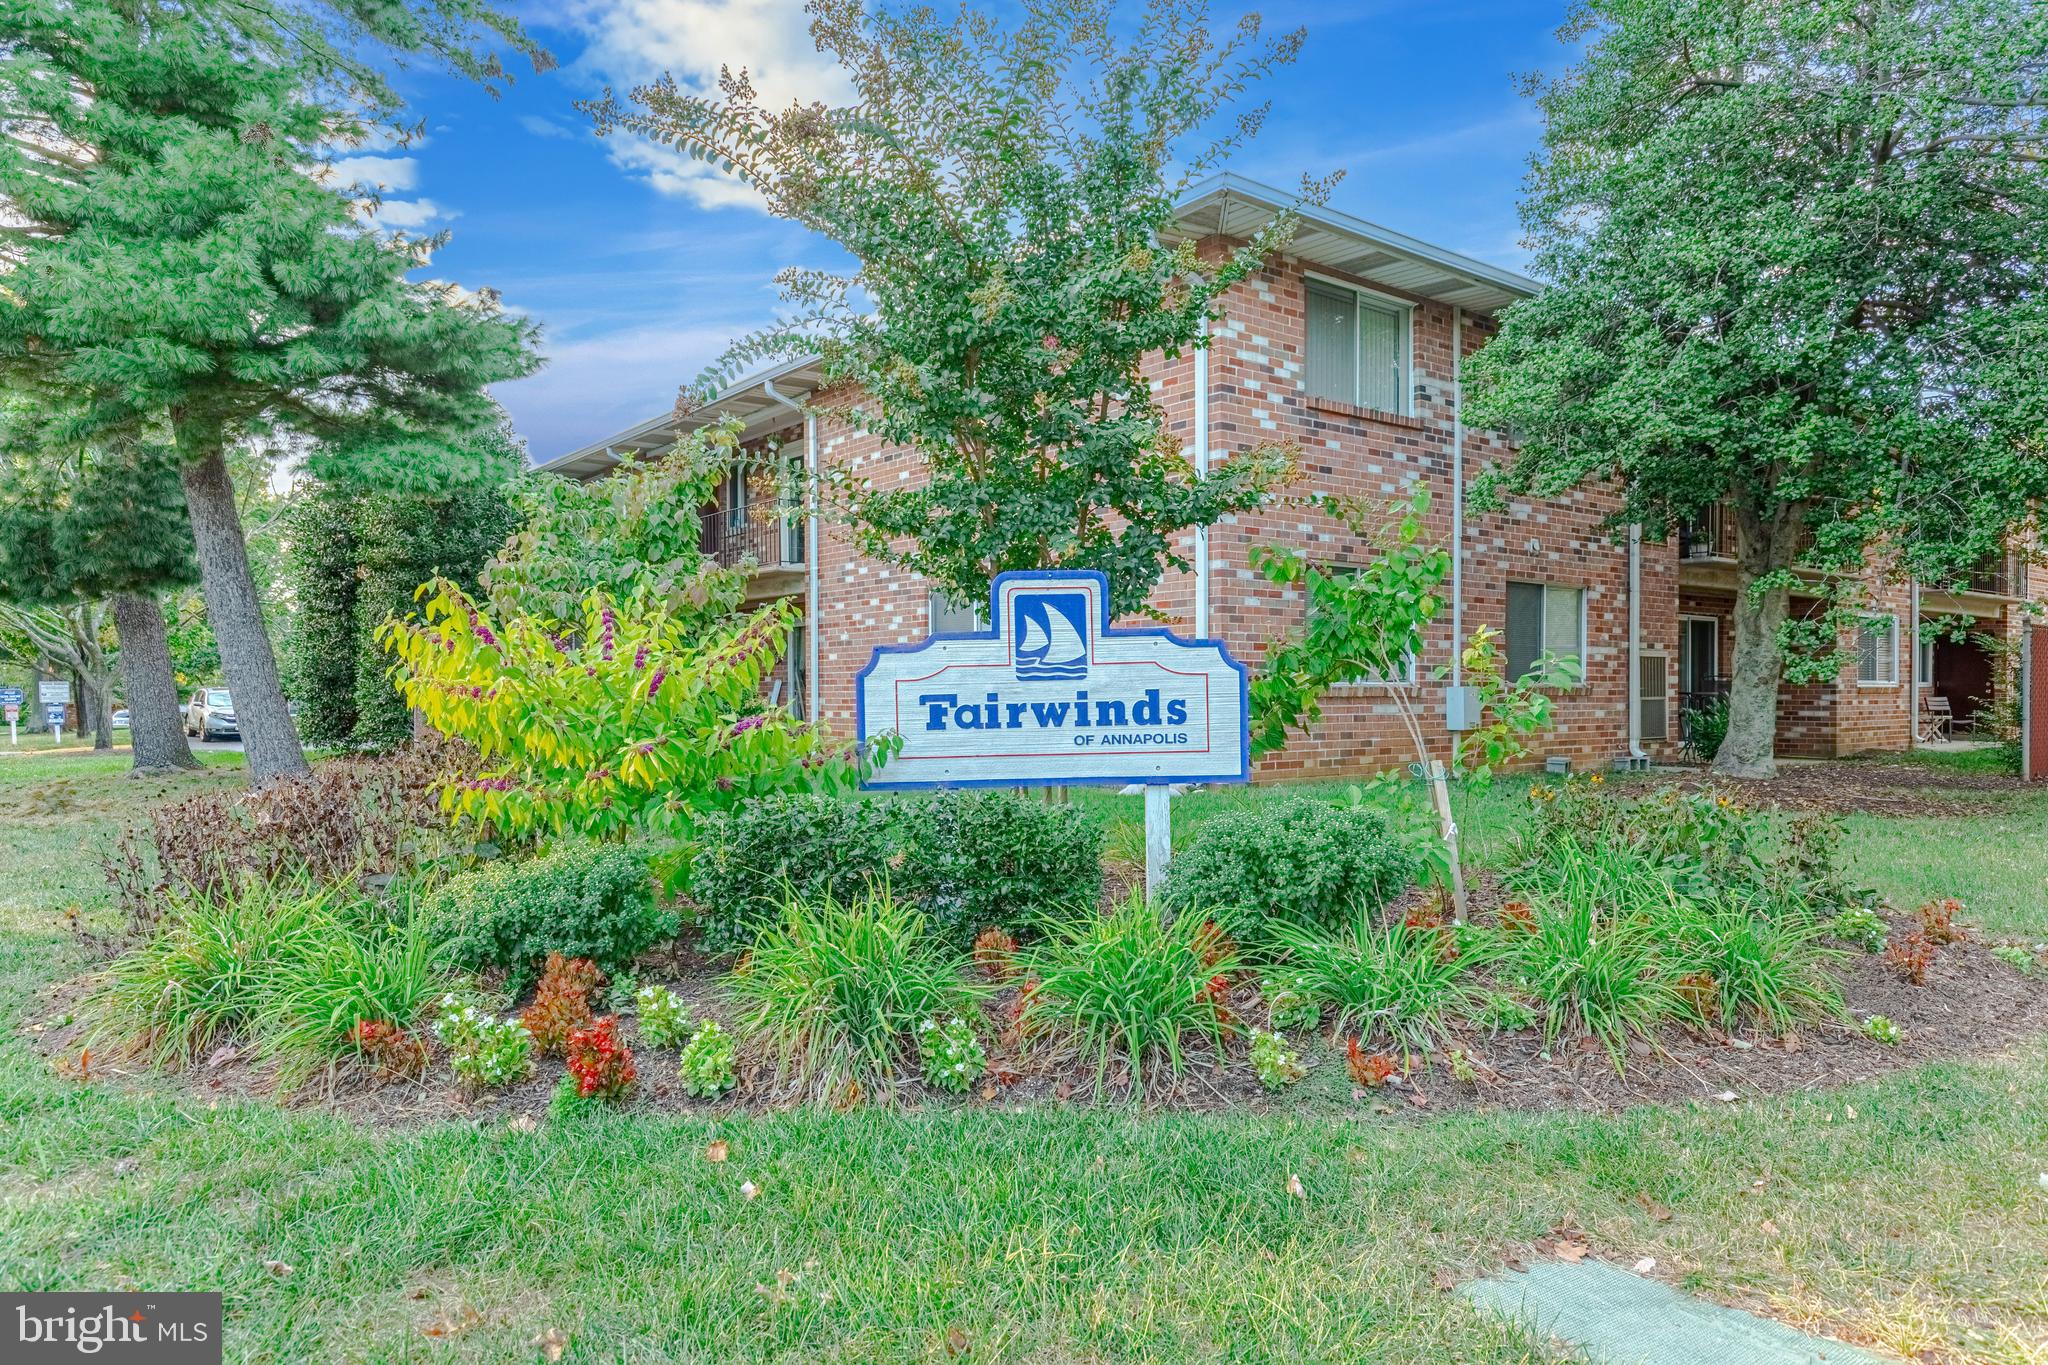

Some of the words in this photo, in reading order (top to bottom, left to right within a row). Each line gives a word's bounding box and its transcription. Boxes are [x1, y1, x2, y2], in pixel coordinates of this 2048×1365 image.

[918, 688, 1188, 730] Fairwinds
[1073, 734, 1096, 747] OF
[1100, 732, 1189, 746] ANNAPOLIS
